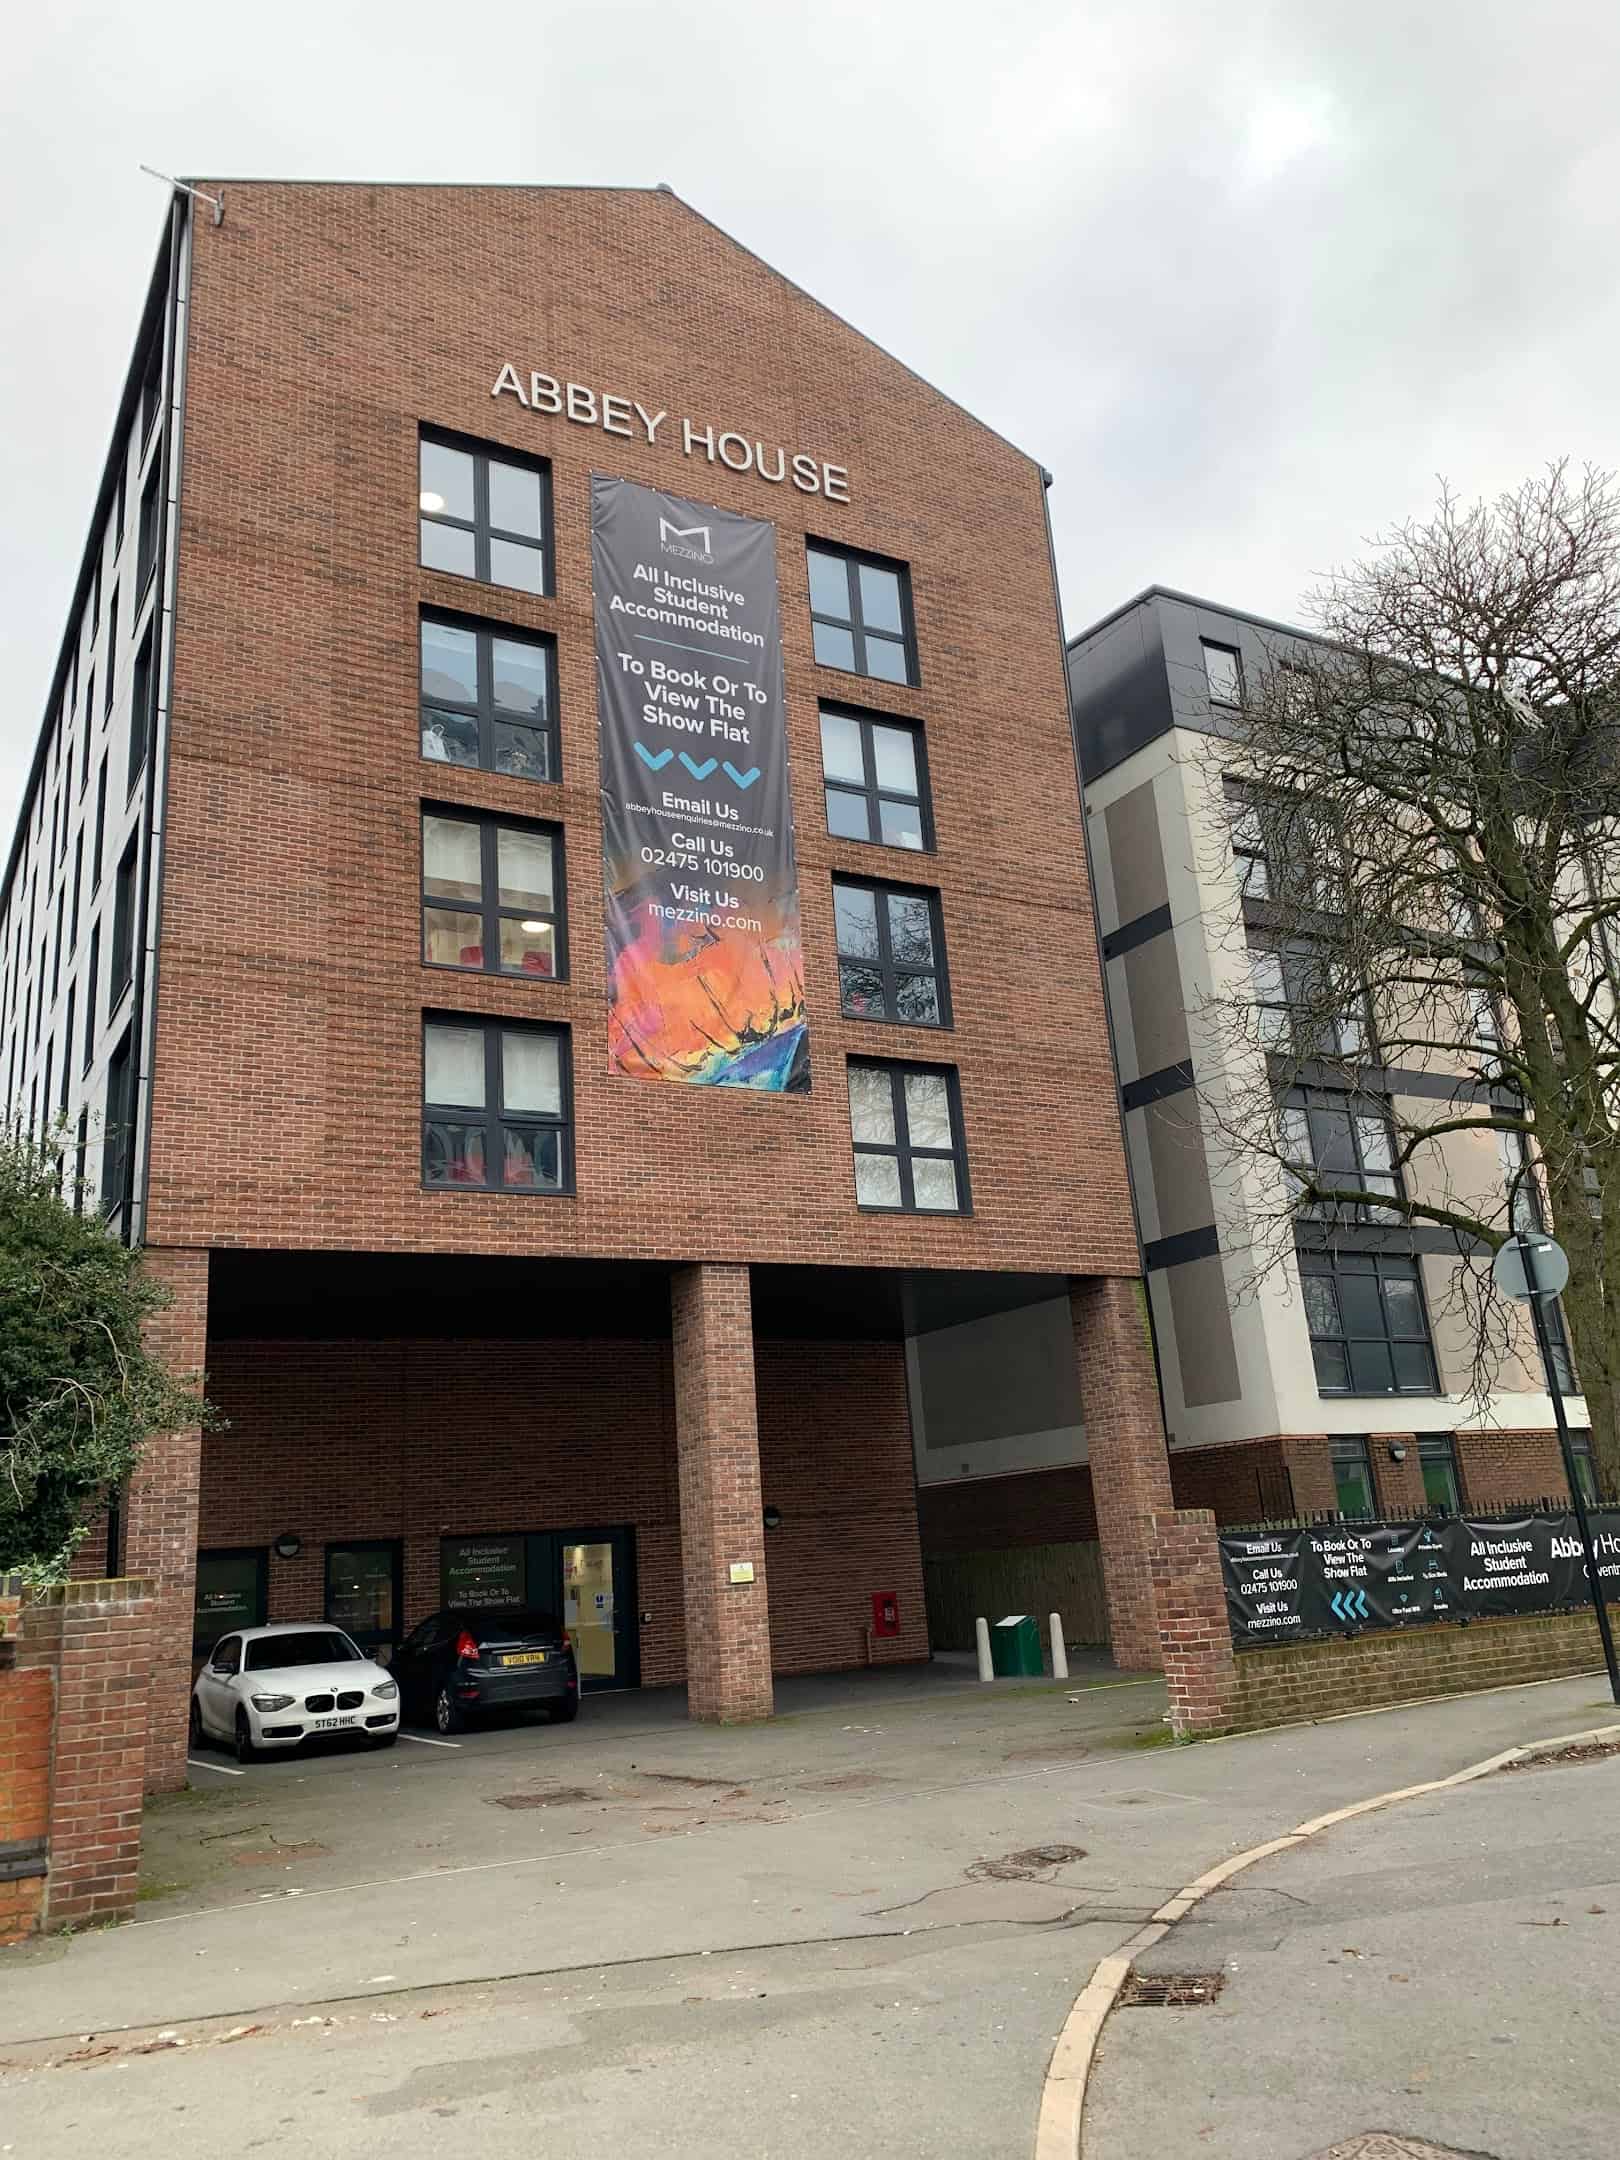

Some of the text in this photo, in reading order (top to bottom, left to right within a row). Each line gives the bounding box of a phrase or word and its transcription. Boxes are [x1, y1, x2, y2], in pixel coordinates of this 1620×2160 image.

[491, 363, 850, 503] ABBEY HOUSE
[660, 542, 714, 565] MEZZINO
[633, 564, 745, 606] All Inclusive
[654, 587, 729, 620] Student
[609, 595, 764, 648] Accommodation
[617, 652, 767, 704] To Book Or To
[644, 681, 745, 720] View The
[643, 704, 750, 745] Show Flat
[662, 791, 739, 821] Email Us
[671, 832, 734, 858] Call Us
[641, 846, 764, 882] 02475 101900
[670, 882, 739, 909] Visit Us
[649, 903, 761, 933] mezzino.com
[1246, 1541, 1282, 1555] Email Us
[1310, 1538, 1371, 1553] To Book Or To
[1471, 1538, 1533, 1557] All Inclusive
[1551, 1536, 1598, 1561] Abby
[1323, 1552, 1364, 1565] View The
[1484, 1556, 1527, 1573] Student
[1252, 1567, 1283, 1580] Call Us
[1324, 1565, 1368, 1579] Show Flat
[1463, 1571, 1549, 1592] Accommodation
[1240, 1579, 1298, 1595] 02475 101900
[1256, 1600, 1289, 1615] Visit Us
[1247, 1615, 1301, 1630] mezzino.com
[315, 1715, 356, 1729] ST62 HHC
